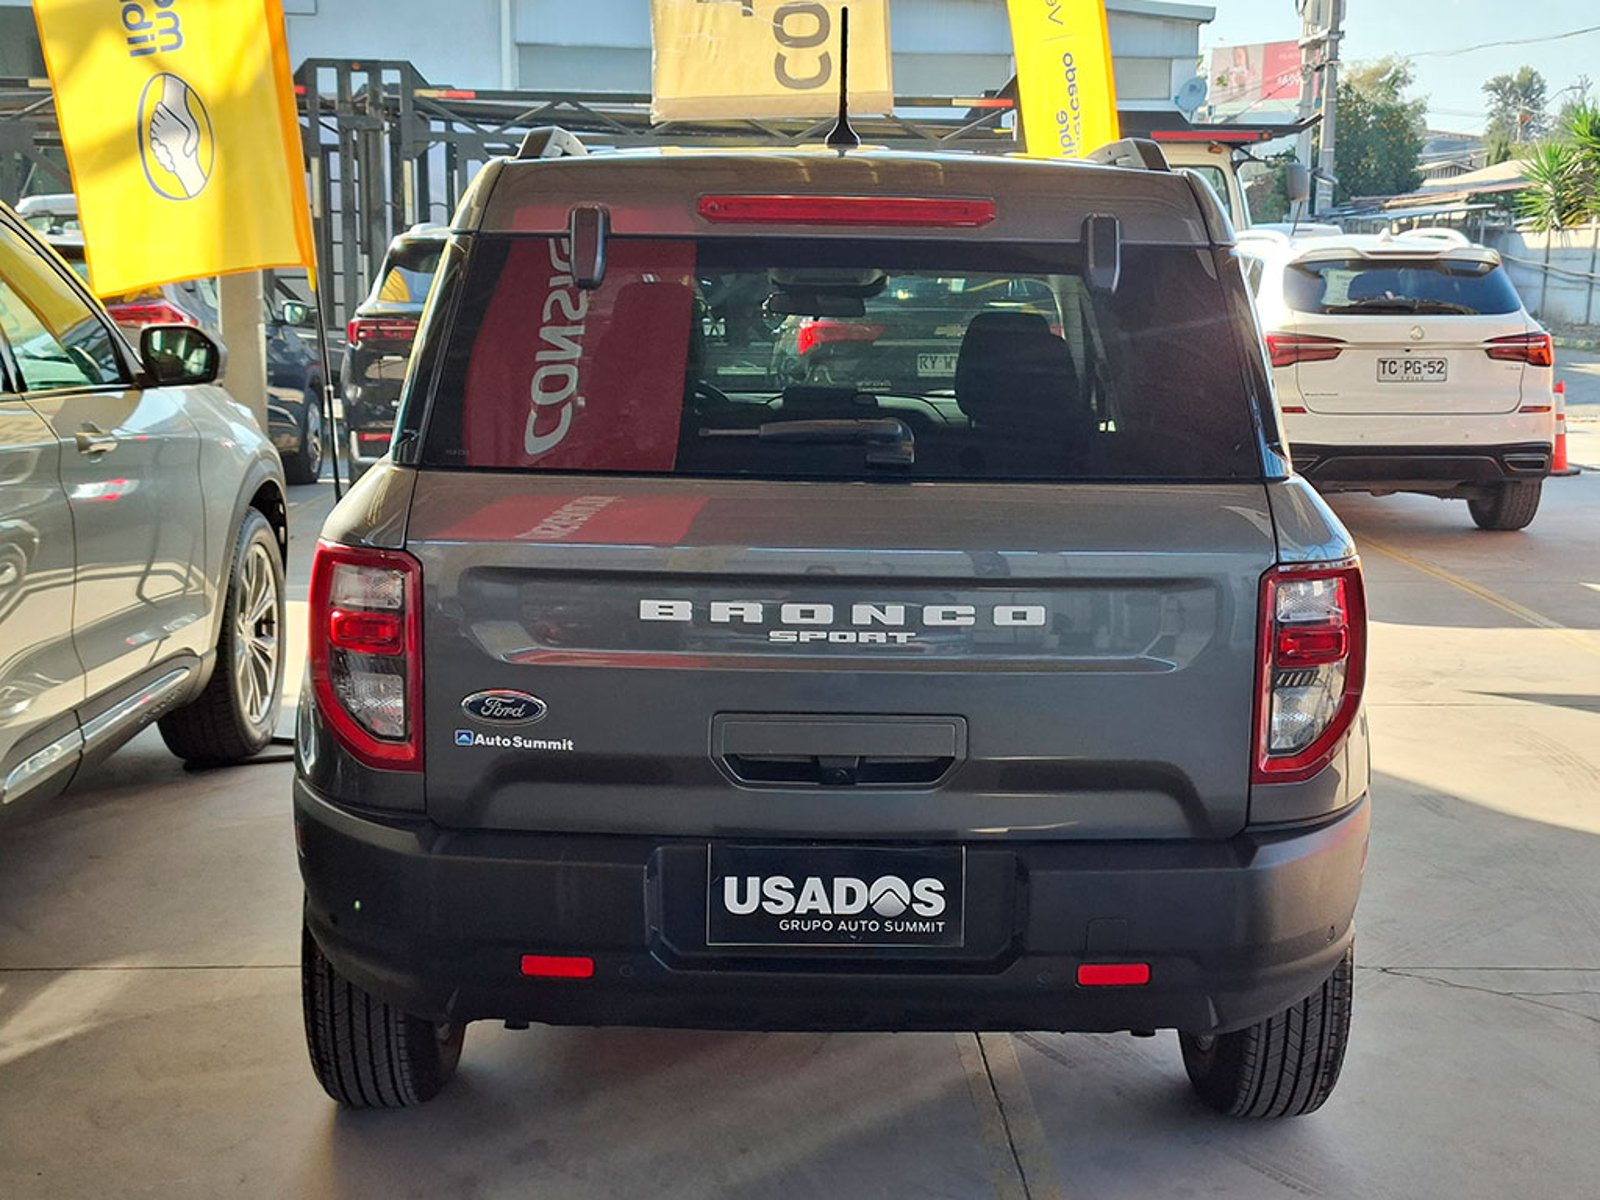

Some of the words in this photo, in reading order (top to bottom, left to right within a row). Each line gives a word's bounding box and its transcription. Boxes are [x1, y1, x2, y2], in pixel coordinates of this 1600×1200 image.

[640, 600, 1046, 626] BRONCO
[769, 630, 916, 644] SPORT
[480, 696, 527, 719] Ford
[724, 875, 946, 918] USADOS
[779, 919, 833, 932] GRUPO
[837, 920, 880, 933] AUTO
[884, 921, 946, 933] SUMMIT
